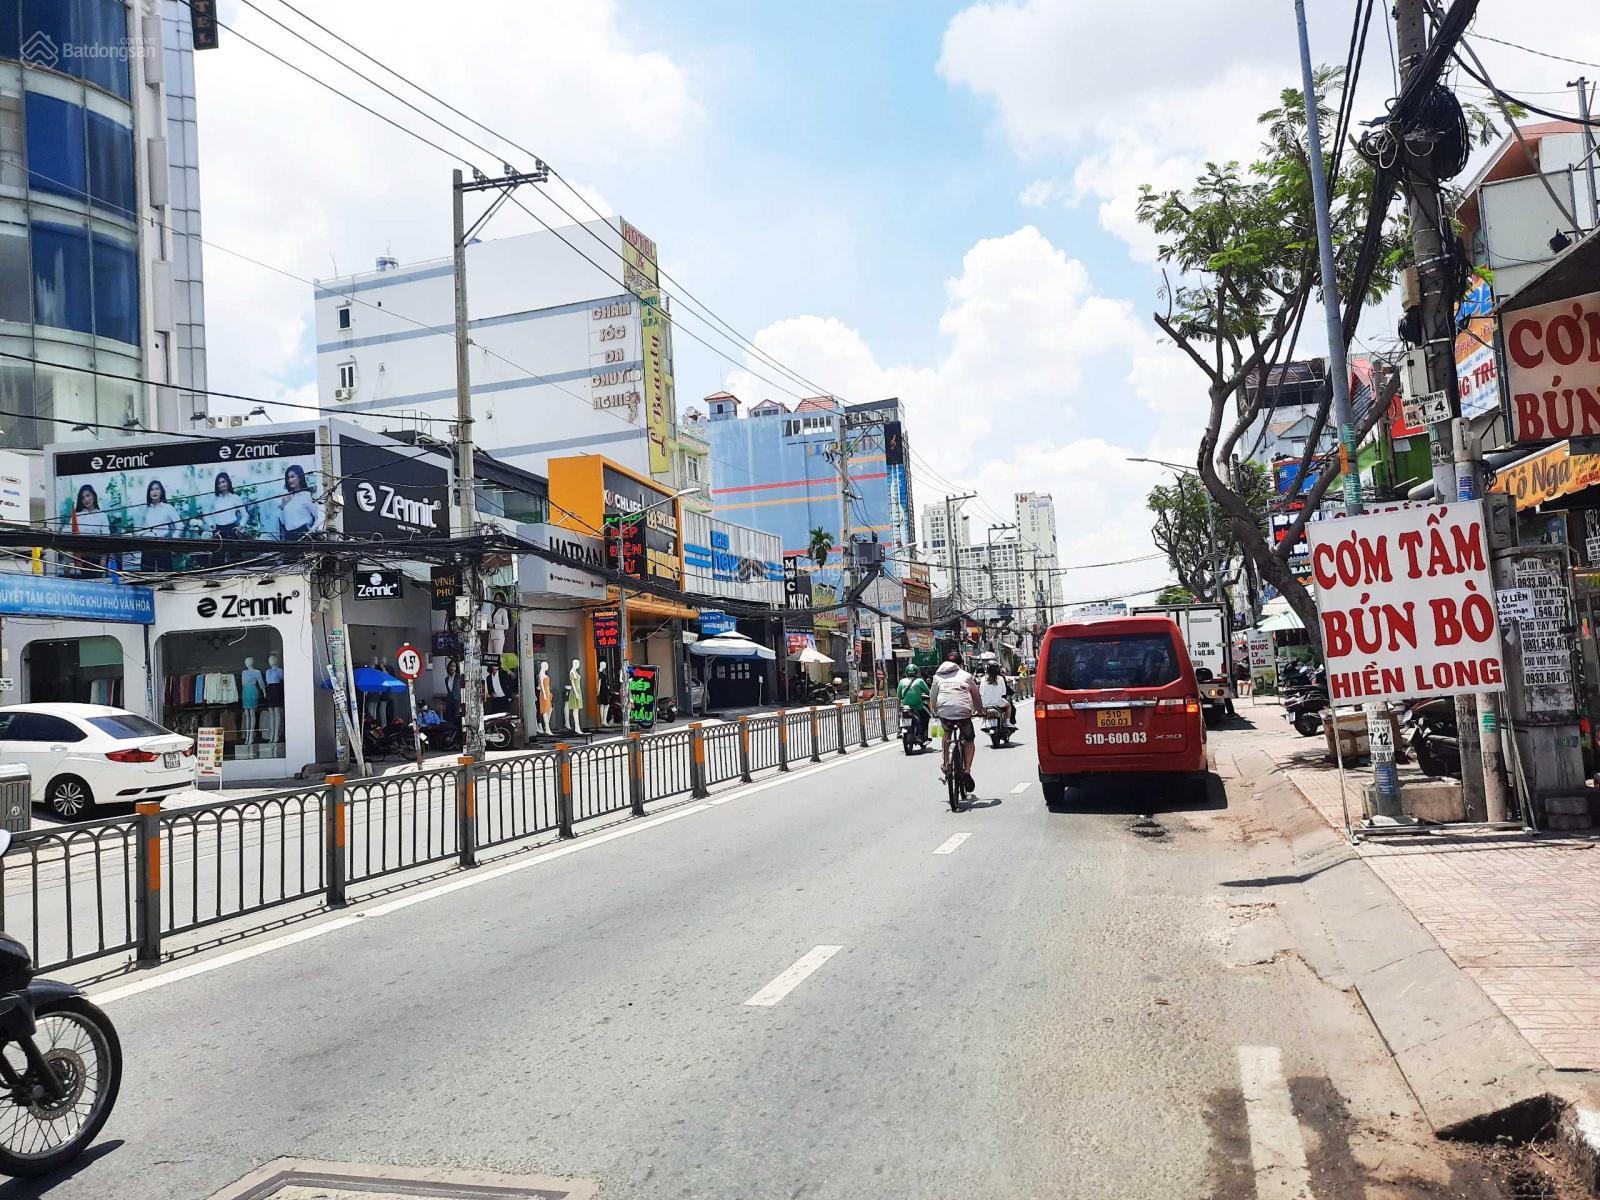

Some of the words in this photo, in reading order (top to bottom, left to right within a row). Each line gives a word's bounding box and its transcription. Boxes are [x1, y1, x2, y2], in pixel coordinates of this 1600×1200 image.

[1434, 401, 1445, 412] 4
[235, 442, 280, 459] Zennic
[106, 454, 149, 470] Zennic
[1532, 457, 1572, 497] Nga
[379, 485, 438, 528] Zennic
[1313, 530, 1393, 590] CƠM
[1399, 508, 1487, 580] TẤM
[357, 583, 395, 597] Zennic
[1510, 591, 1529, 602] LIỀN
[221, 593, 293, 618] Zennic
[789, 593, 810, 610] MWC
[1321, 592, 1418, 658] BÚN
[1428, 579, 1496, 647] BÒ
[1520, 621, 1534, 631] CHO
[1536, 656, 1546, 666] VAY
[1331, 661, 1406, 700] HIỀN
[1414, 656, 1503, 694] LONG
[1101, 717, 1129, 727] 600.03
[1106, 710, 1122, 719] 51D
[1085, 731, 1148, 745] 51D-600.03
